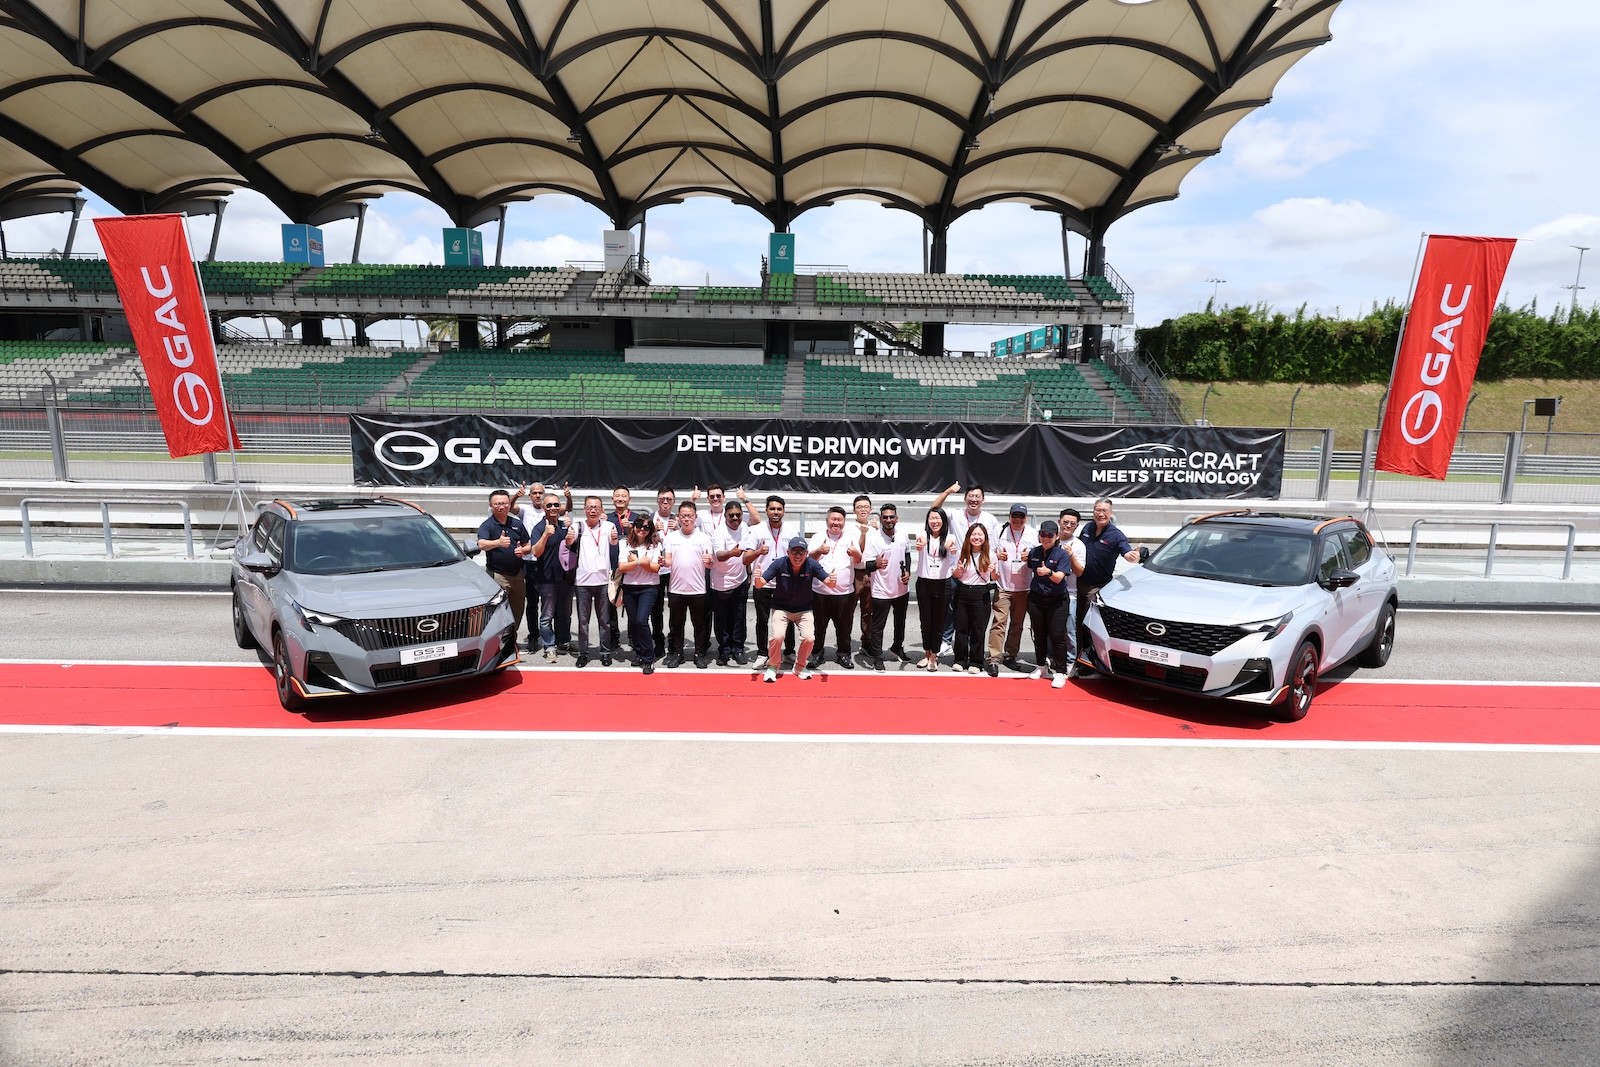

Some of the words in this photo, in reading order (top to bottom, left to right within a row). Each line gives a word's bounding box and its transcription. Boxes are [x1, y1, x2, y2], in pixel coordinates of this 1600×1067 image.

[140, 265, 195, 368] GAC
[1420, 283, 1472, 386] GAC
[444, 437, 557, 466] GAC
[676, 434, 802, 453] DEFENSIVE
[807, 436, 902, 455] DRIVING
[905, 437, 965, 455] WITH
[749, 458, 791, 476] GS3
[795, 459, 899, 478] EMZOOM
[1139, 457, 1187, 468] WHERE
[1188, 452, 1262, 471] CRAFT
[1092, 470, 1149, 483] MEETS
[1153, 470, 1261, 485] TECHNOLOGY
[413, 646, 445, 657] GS3
[1140, 647, 1169, 658] GS3
